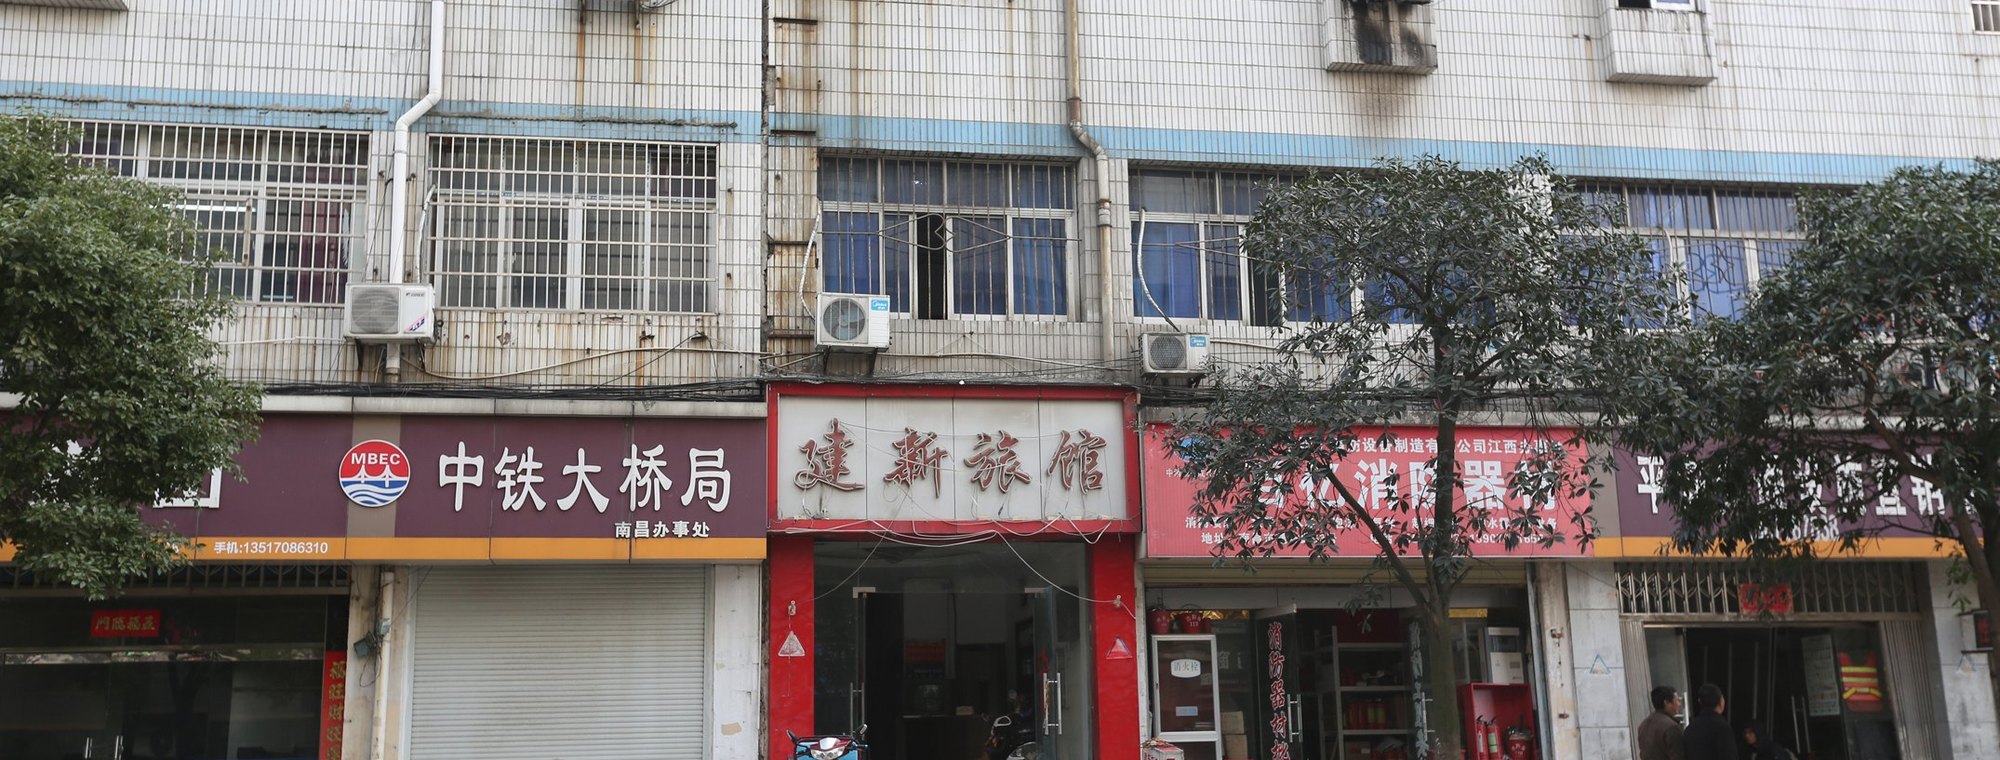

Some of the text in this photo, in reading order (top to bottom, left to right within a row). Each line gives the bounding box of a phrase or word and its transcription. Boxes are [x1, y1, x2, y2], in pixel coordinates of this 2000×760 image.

[350, 452, 401, 466] MBEC
[793, 417, 1107, 498] 建新旅馆
[438, 440, 732, 514] 中铁大桥局
[614, 520, 710, 538] 南昌办事处
[213, 541, 329, 555] 手机:13517086310
